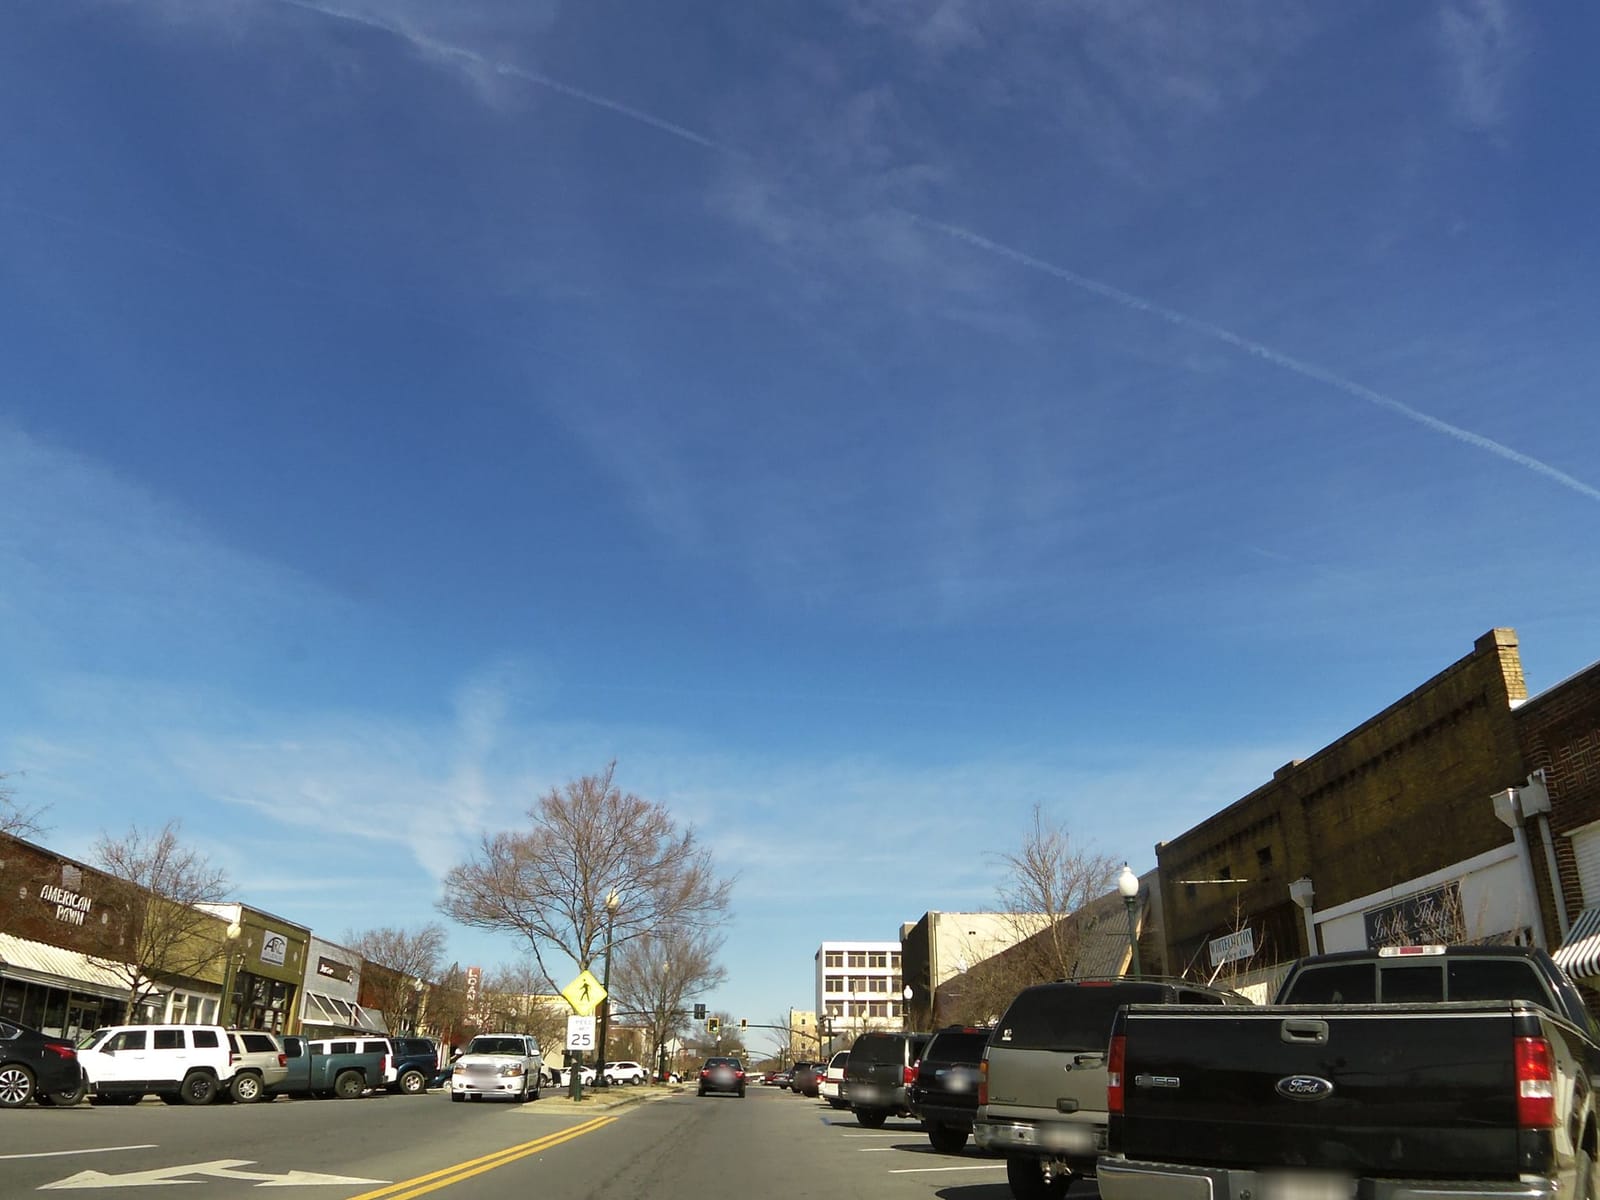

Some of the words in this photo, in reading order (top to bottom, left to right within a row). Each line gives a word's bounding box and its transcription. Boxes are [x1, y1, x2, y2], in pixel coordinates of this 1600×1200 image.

[40, 884, 92, 912] AMERICAN
[55, 904, 85, 926] PAWN
[570, 1033, 591, 1046] 25
[1288, 1079, 1319, 1093] Ford
